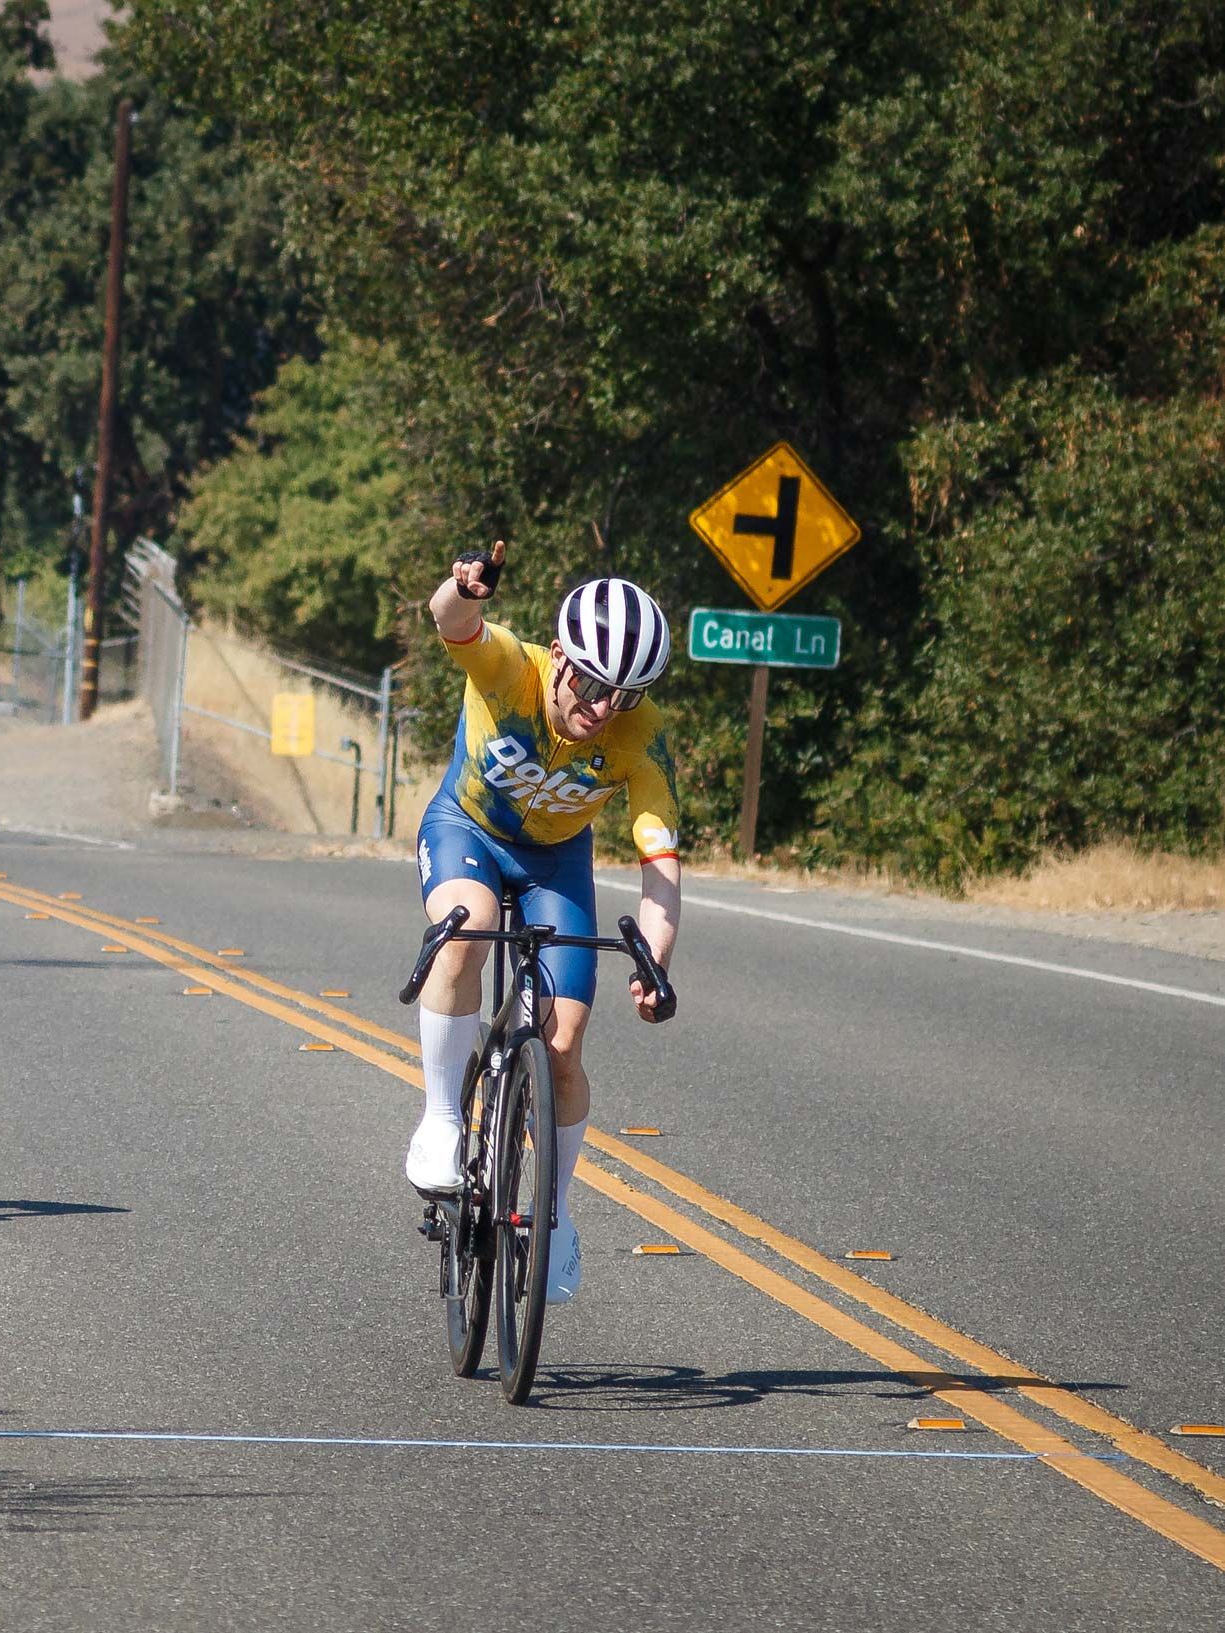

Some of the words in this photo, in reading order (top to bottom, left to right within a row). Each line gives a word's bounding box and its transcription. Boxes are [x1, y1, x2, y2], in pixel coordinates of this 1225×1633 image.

[703, 620, 773, 651] Canal
[795, 627, 825, 655] Ln
[484, 763, 588, 814] Vita
[486, 735, 614, 803] Dolce
